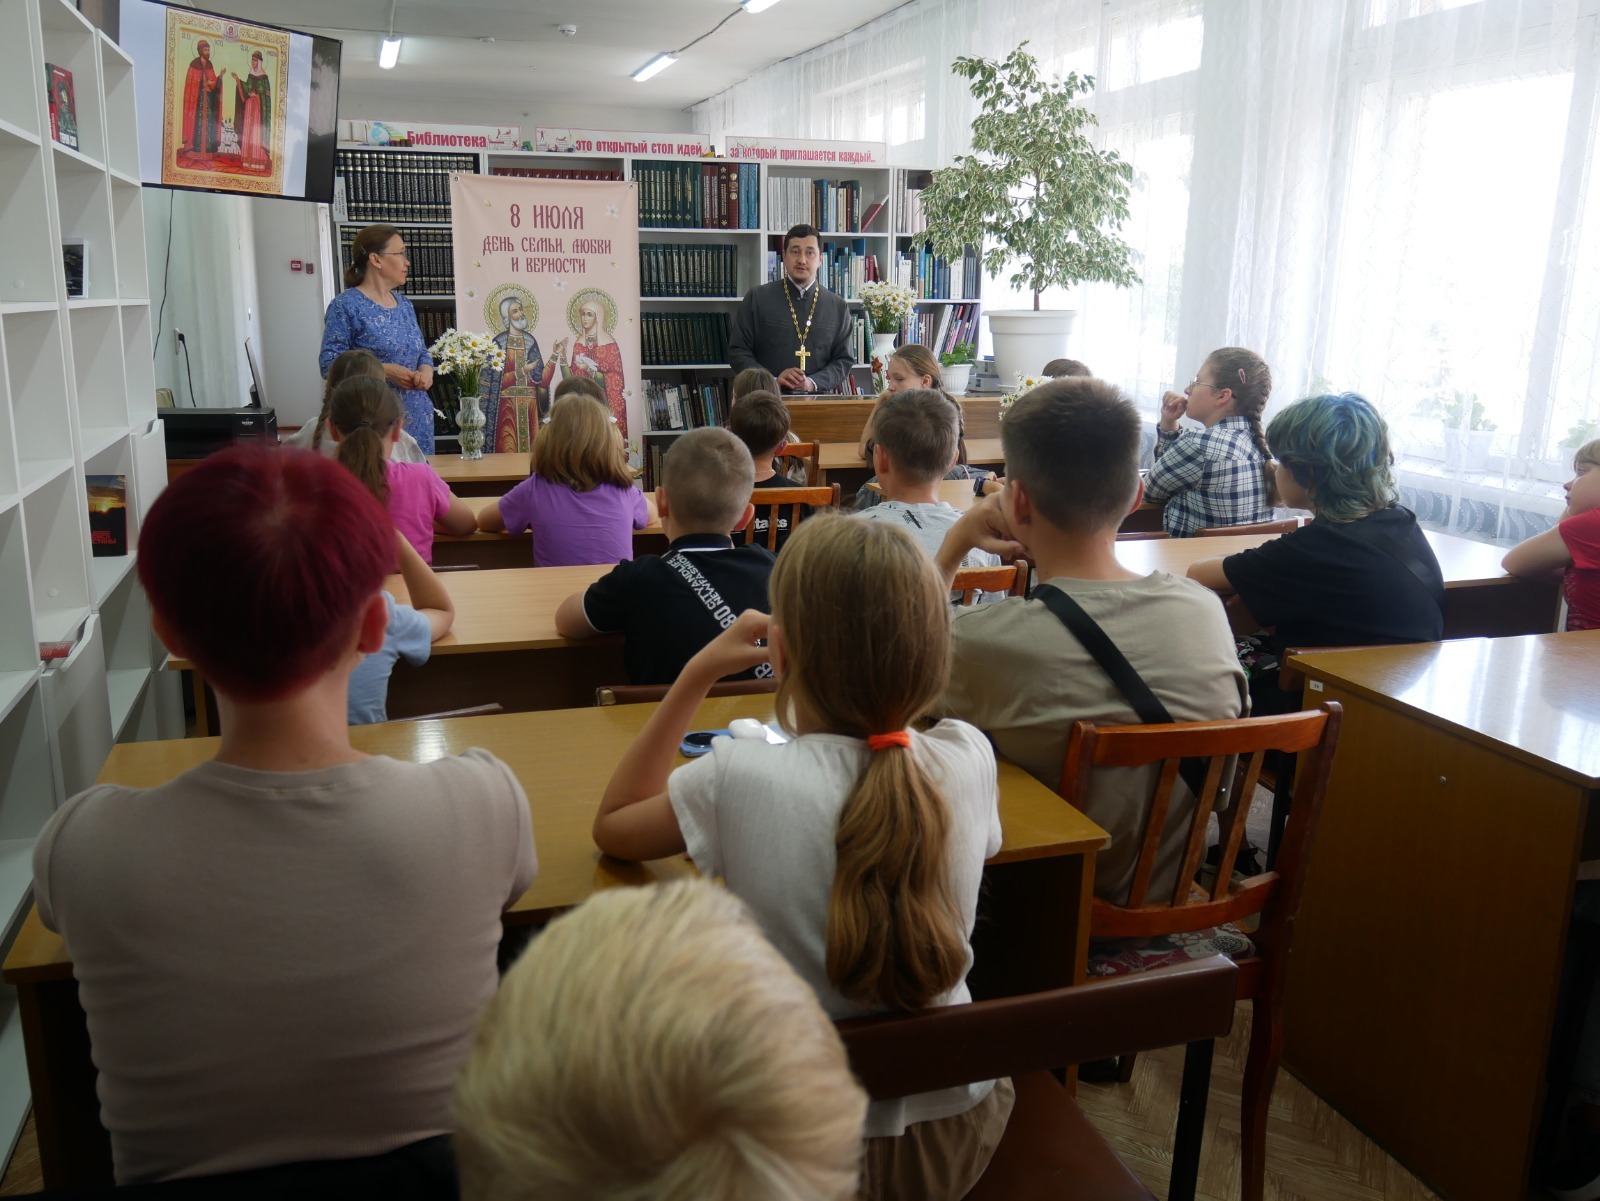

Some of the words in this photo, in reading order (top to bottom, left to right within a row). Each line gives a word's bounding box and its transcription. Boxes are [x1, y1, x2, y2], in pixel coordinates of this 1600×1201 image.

[407, 130, 487, 148] Библиотека
[575, 139, 592, 152] это
[596, 139, 648, 154] открытый
[651, 142, 674, 155] стол
[729, 146, 739, 158] за
[742, 145, 777, 160] который
[780, 148, 836, 162] приглашается
[510, 203, 521, 228] 8
[533, 204, 584, 230] ИЮЛЯ
[482, 235, 515, 256] ДЕНЬ
[521, 236, 565, 254] СЕМЬИ,
[572, 238, 612, 255] ЛЮБВИ
[511, 256, 519, 273] И
[525, 256, 586, 274] ВЕРНОСТИ
[666, 557, 716, 611] CITYANDLIFE
[673, 552, 724, 606] NEWFASHION
